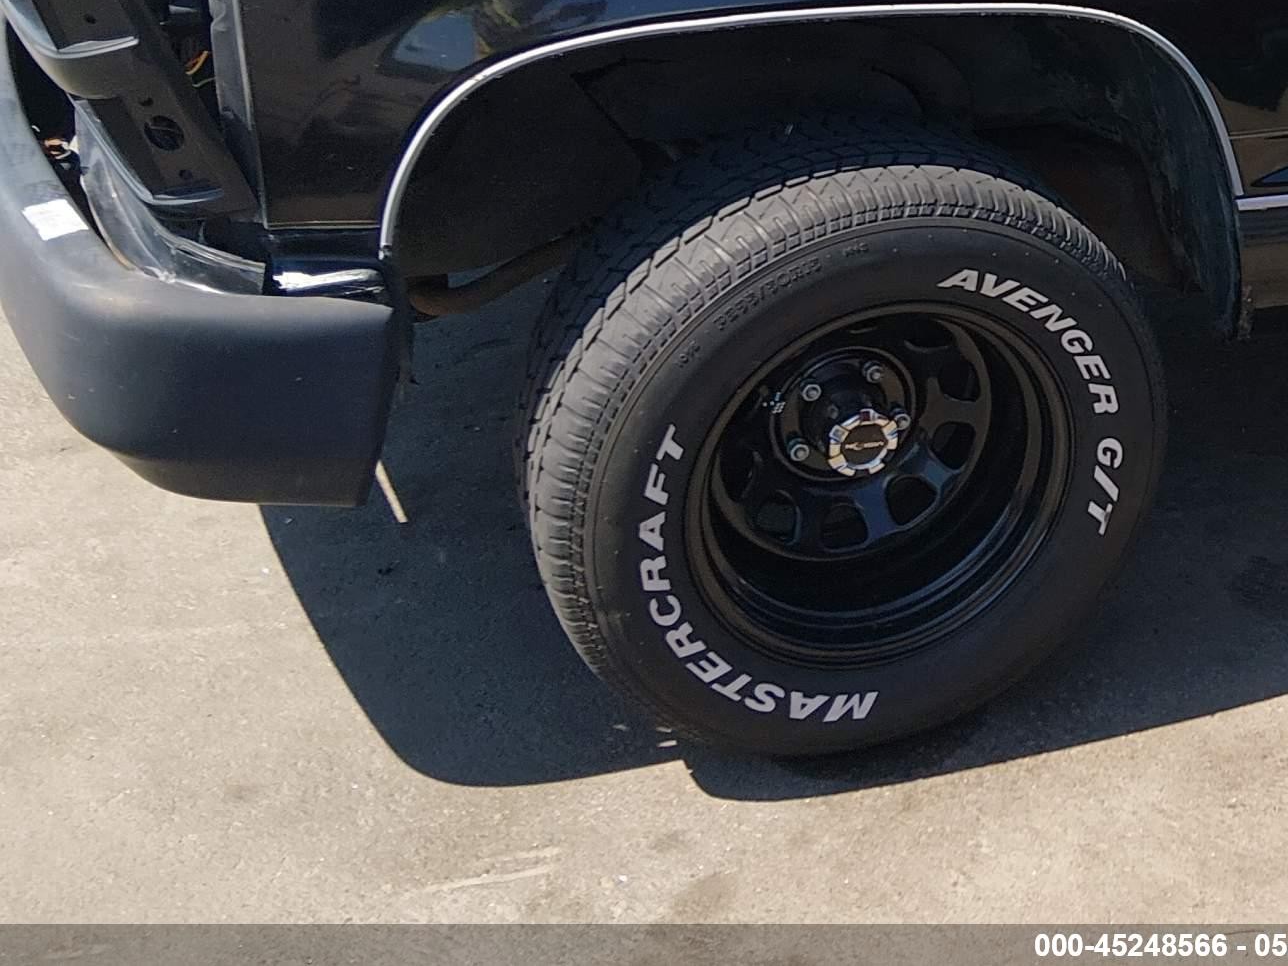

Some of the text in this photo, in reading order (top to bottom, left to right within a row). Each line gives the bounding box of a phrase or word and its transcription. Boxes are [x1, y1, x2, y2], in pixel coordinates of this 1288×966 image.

[937, 268, 1123, 535] AVENGER G/T
[638, 424, 879, 722] MASTERCRAFT
